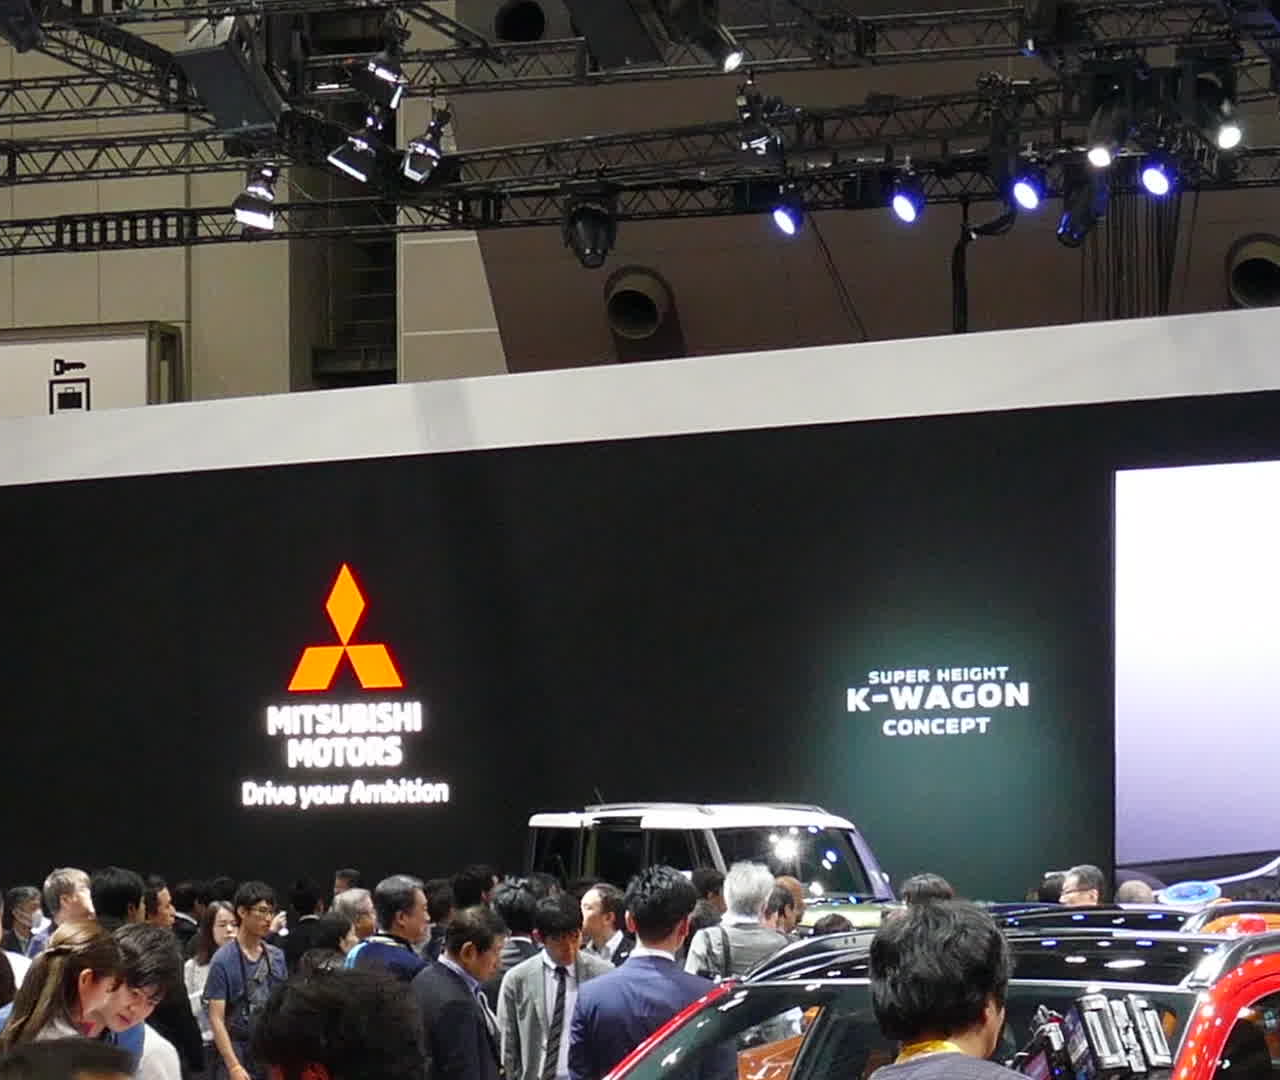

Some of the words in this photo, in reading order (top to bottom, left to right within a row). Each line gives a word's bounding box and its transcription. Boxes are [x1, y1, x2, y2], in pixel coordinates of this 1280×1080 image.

[869, 669, 930, 684] SUPER
[937, 666, 1009, 682] HEIGHT
[846, 682, 1030, 712] K-WAGON
[267, 702, 422, 735] MITSUBISHI
[883, 716, 990, 735] CONCEPT
[287, 736, 403, 768] MOTORS
[241, 781, 297, 806] Drive
[299, 785, 349, 810] your
[349, 778, 450, 804] Ambition
